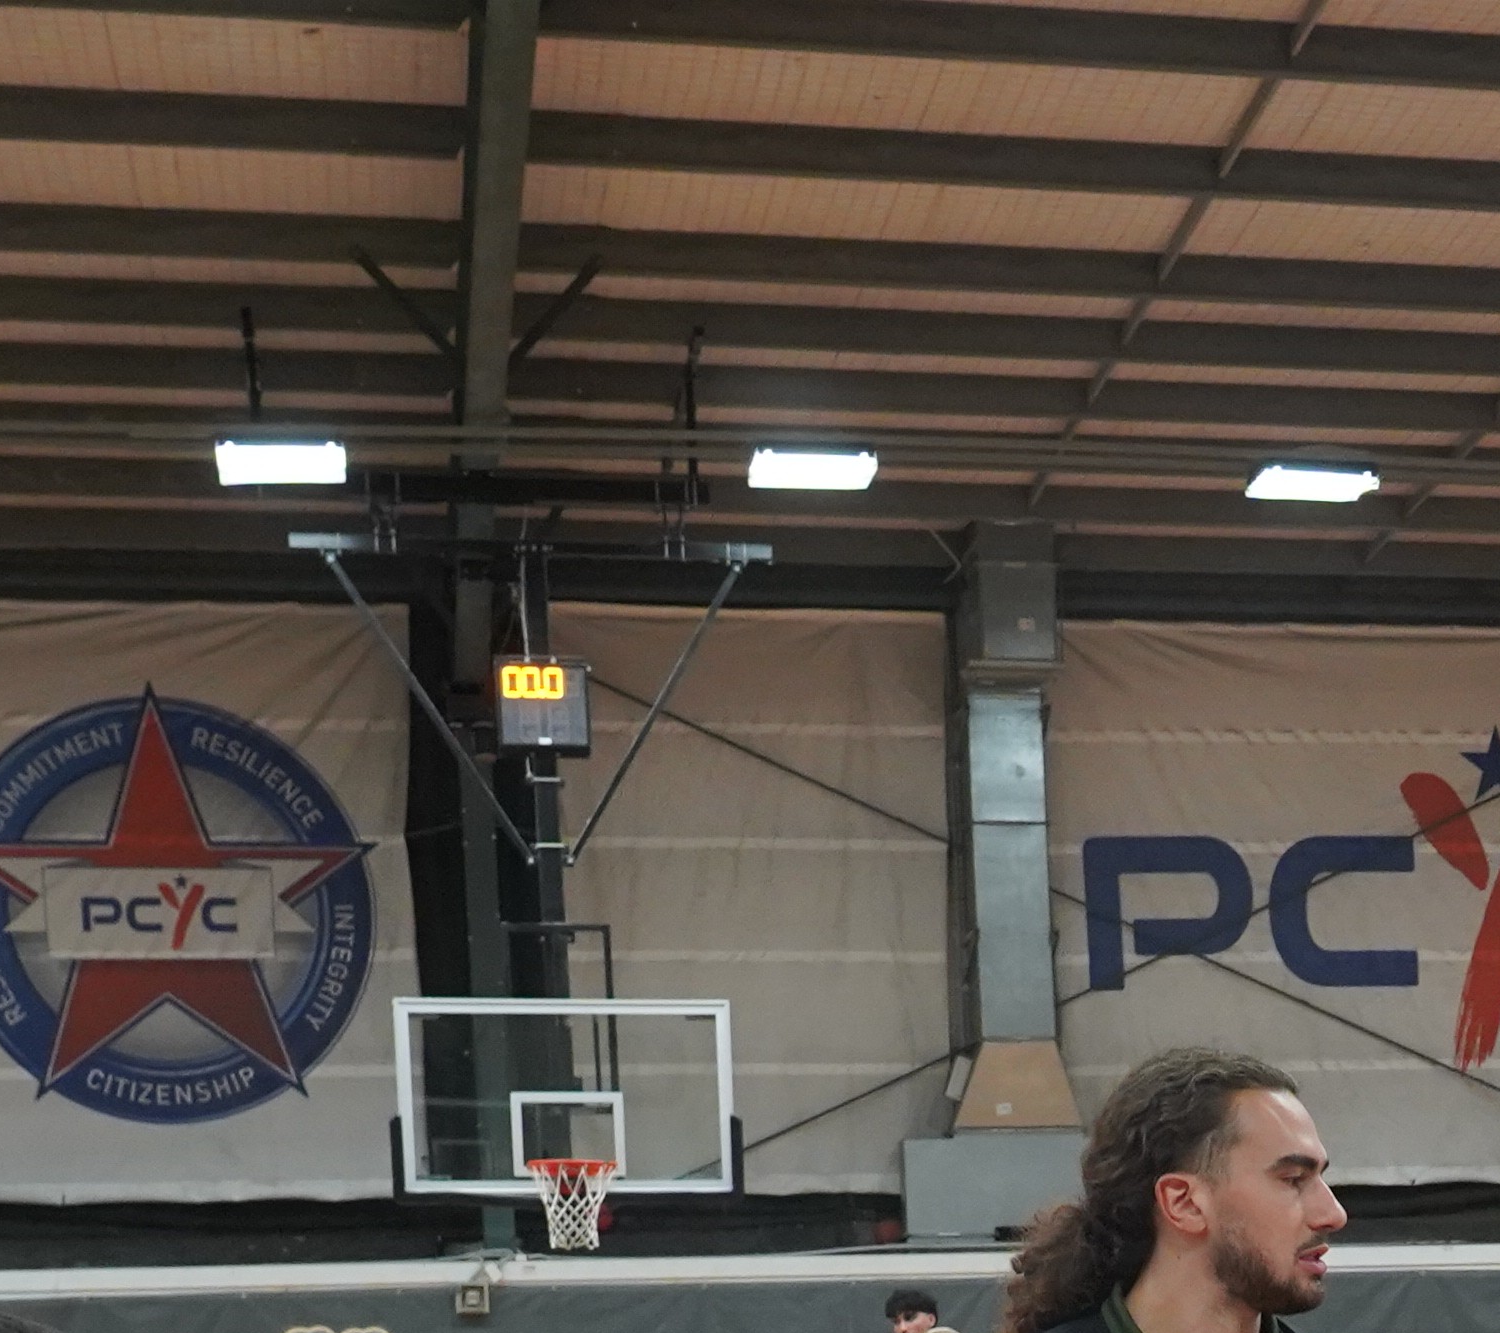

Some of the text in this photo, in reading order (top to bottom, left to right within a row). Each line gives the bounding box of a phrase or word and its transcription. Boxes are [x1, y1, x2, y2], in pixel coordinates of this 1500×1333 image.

[502, 665, 564, 699] 00.0
[191, 726, 325, 829] RESILIENCE
[81, 882, 238, 950] PCYC
[305, 904, 355, 1032] INTEGRITY
[86, 1066, 256, 1105] CITIZENSHIP
